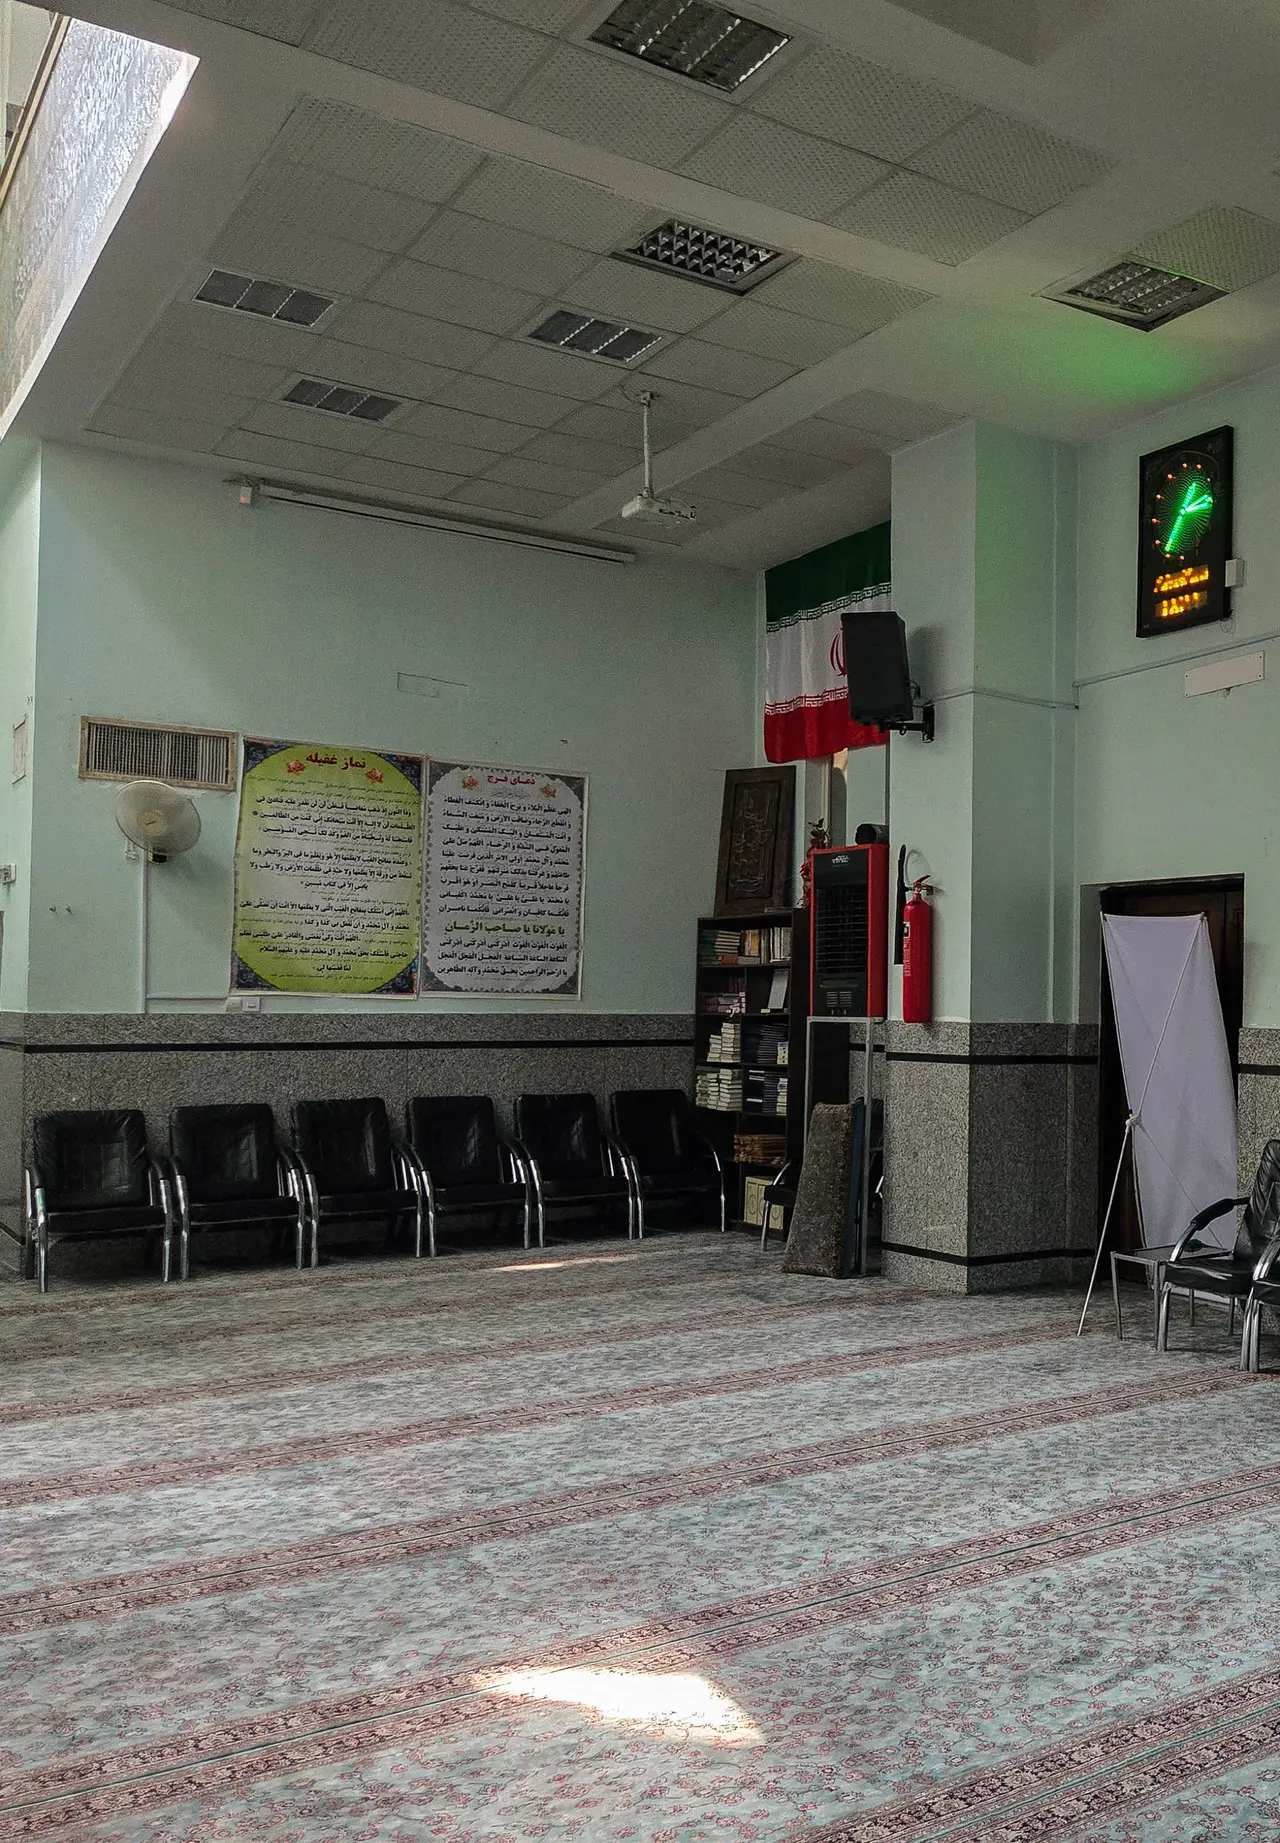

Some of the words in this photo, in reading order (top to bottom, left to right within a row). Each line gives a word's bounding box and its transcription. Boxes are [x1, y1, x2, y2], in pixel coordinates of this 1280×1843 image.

[340, 756, 367, 770] نماز
[487, 774, 508, 784] فرج
[510, 774, 536, 785] دعای
[524, 856, 540, 865] محمد
[554, 859, 569, 867] محمد
[365, 922, 381, 930] محمد
[395, 924, 410, 932] محمد
[444, 920, 483, 934] الزمان
[484, 923, 521, 936] صاحب
[532, 925, 556, 937] مولانا
[312, 948, 327, 956] محمد
[342, 949, 357, 957] محمد
[482, 967, 500, 976] محمد
